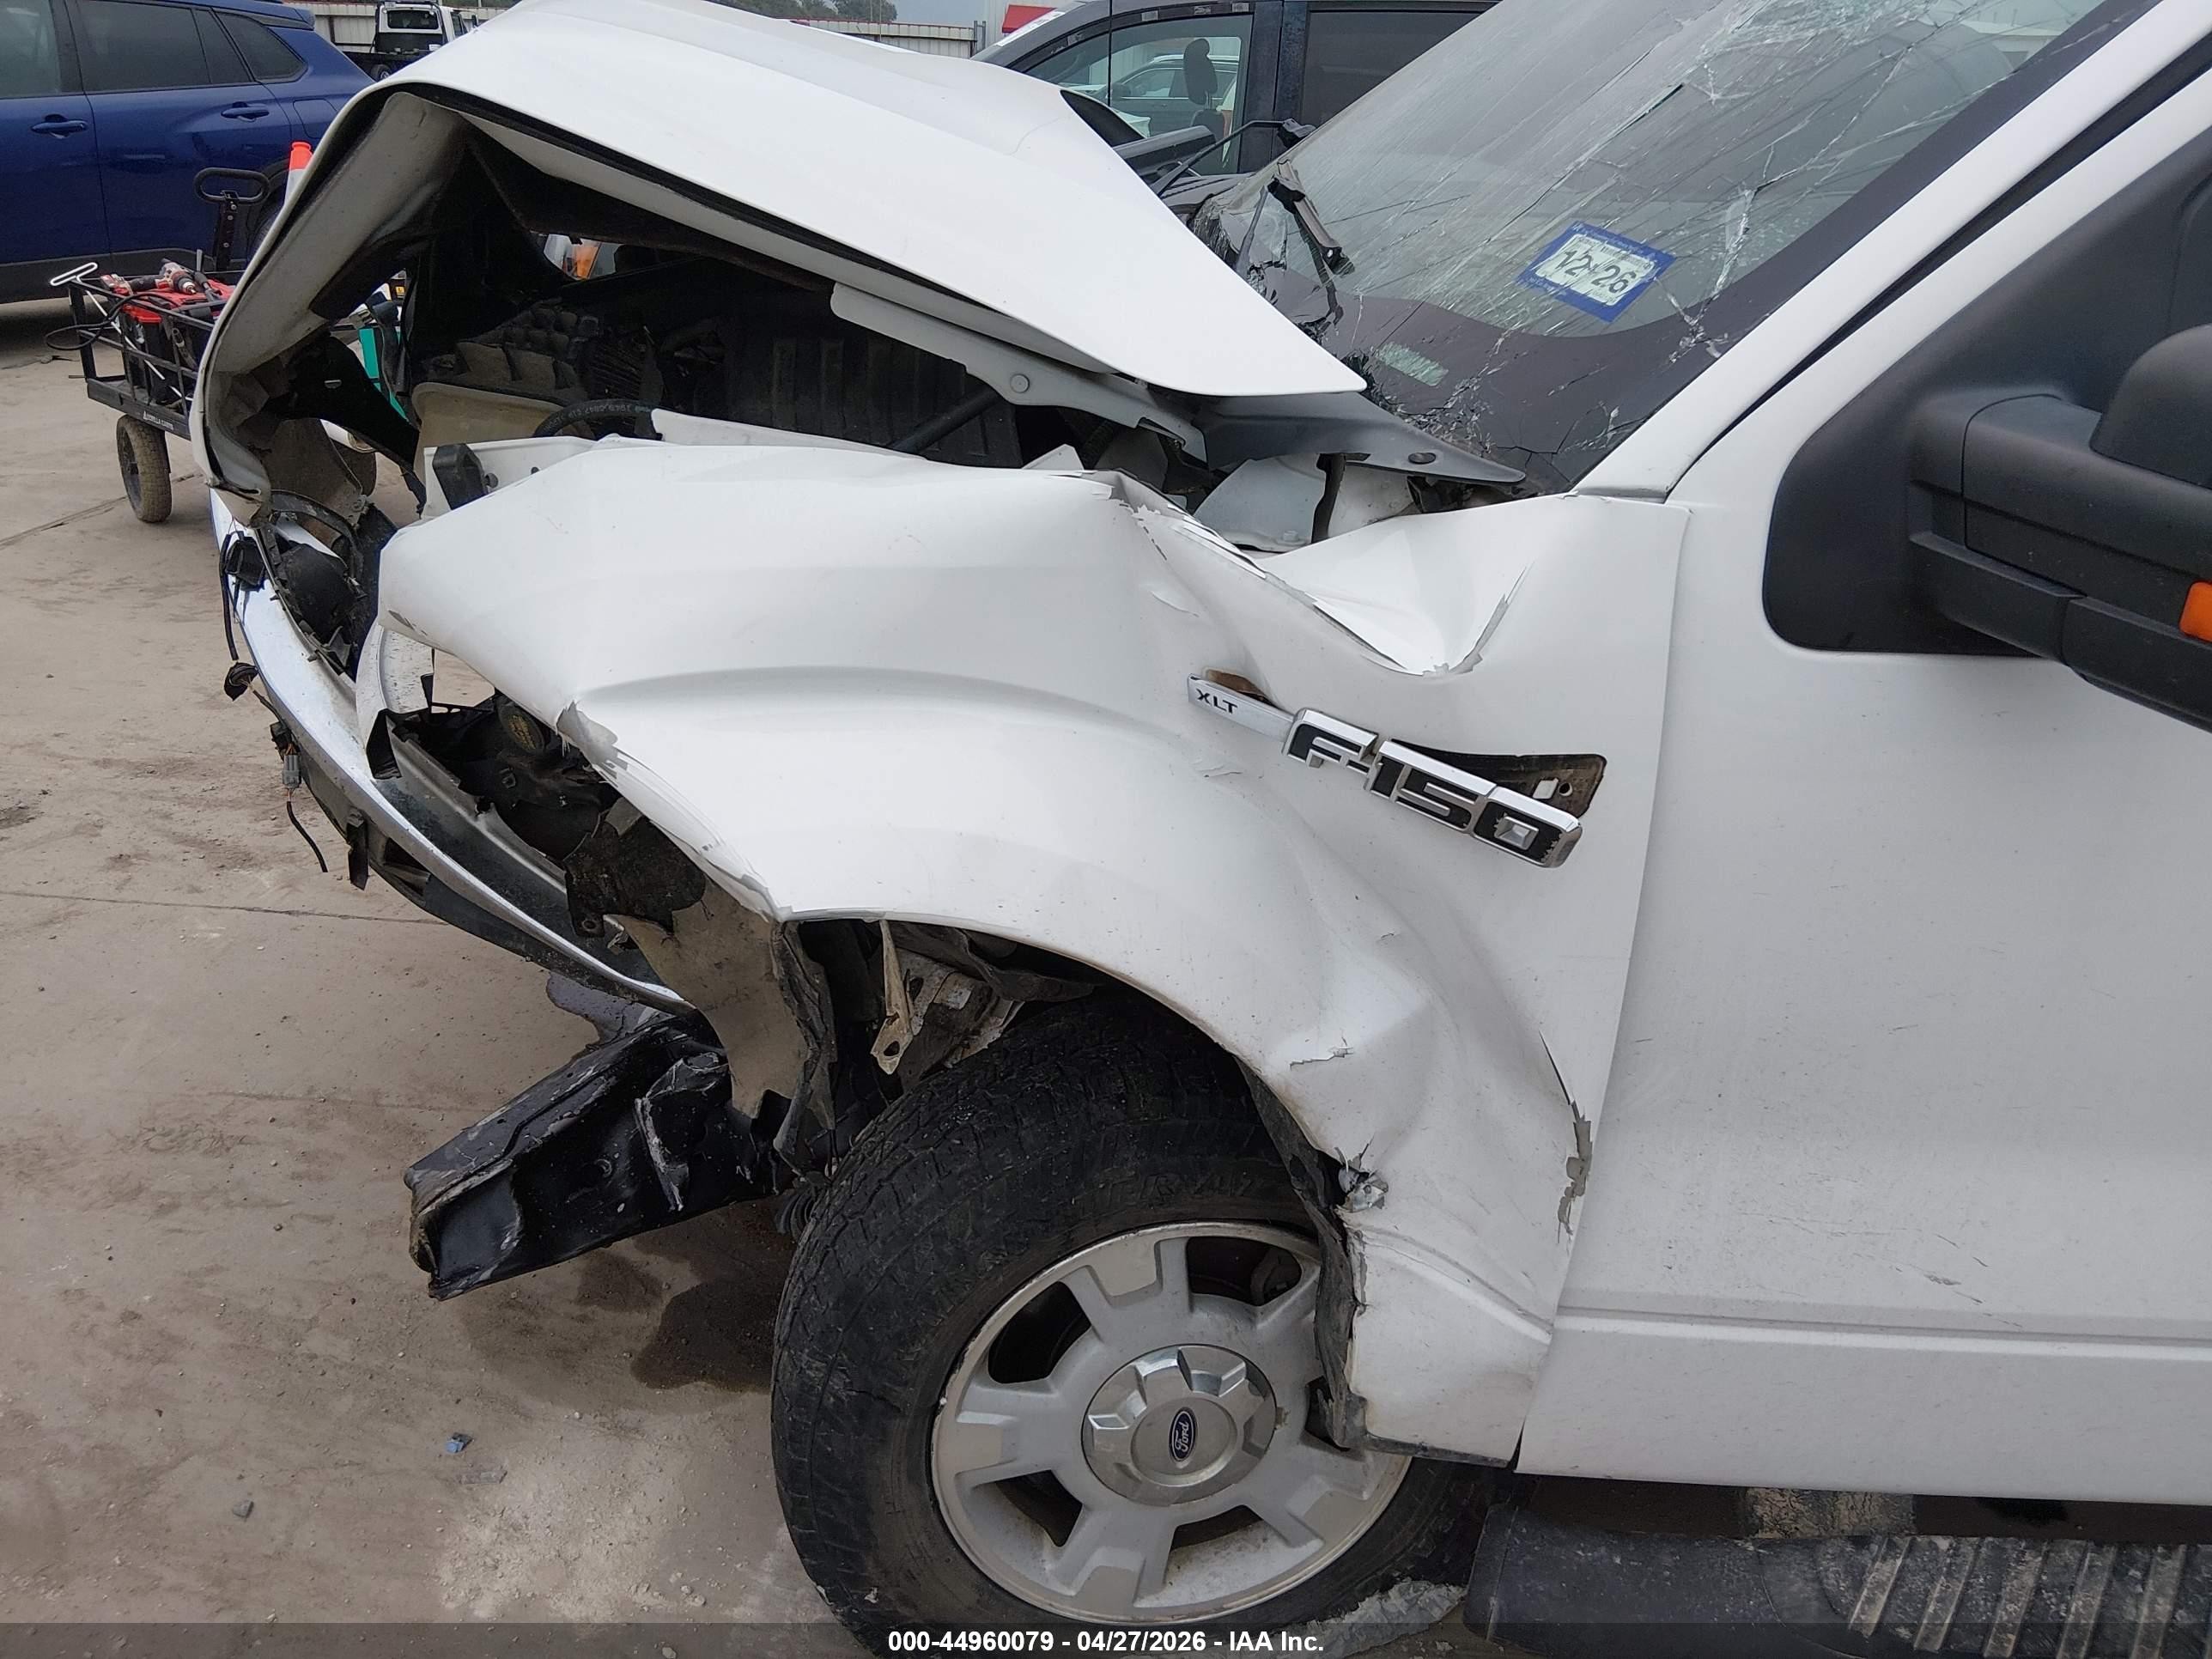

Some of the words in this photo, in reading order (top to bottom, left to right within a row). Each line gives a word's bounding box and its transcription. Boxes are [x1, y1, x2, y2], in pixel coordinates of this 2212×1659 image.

[1196, 688, 1238, 714] XLT
[1282, 708, 1584, 867] F-150
[1175, 1421, 1189, 1452] Ford
